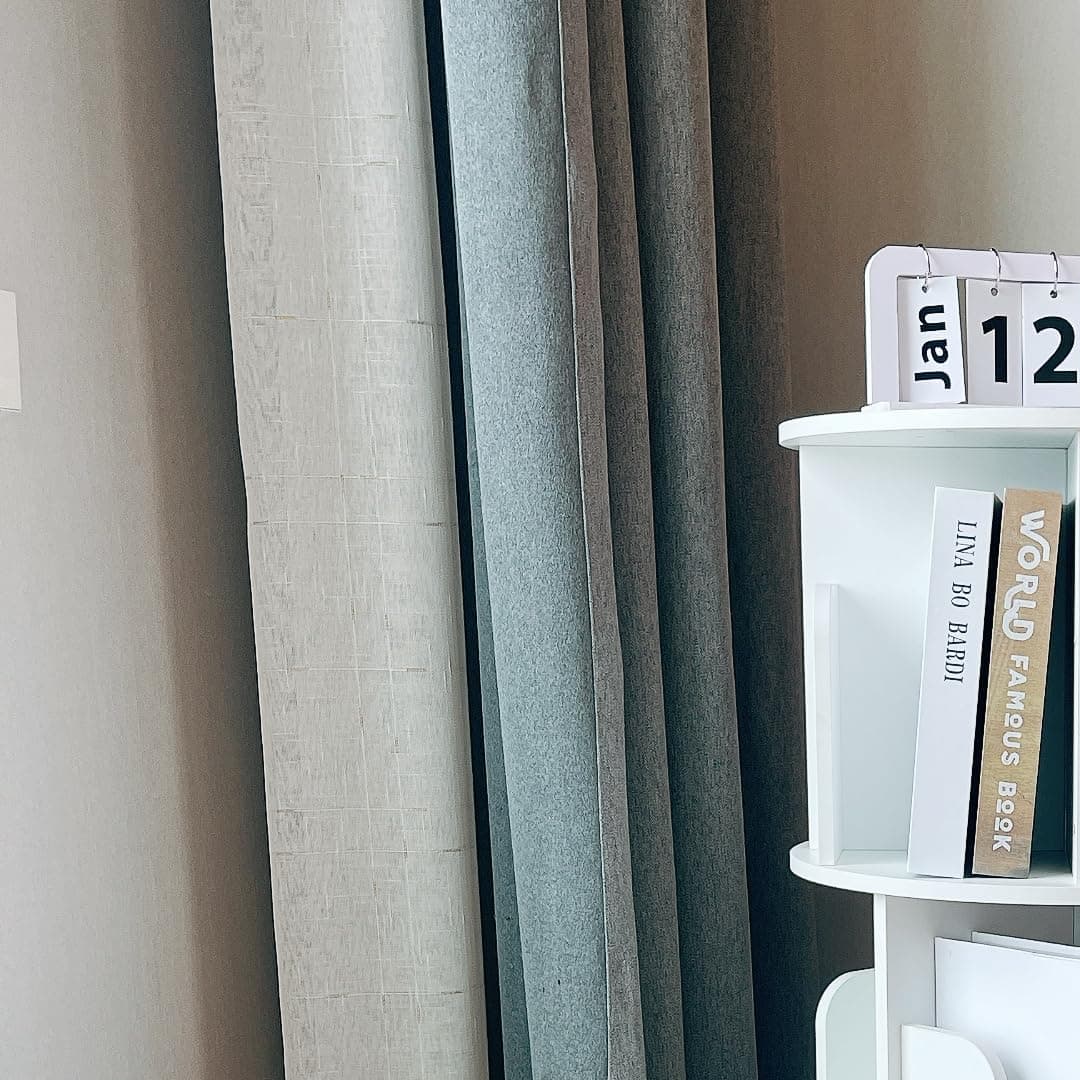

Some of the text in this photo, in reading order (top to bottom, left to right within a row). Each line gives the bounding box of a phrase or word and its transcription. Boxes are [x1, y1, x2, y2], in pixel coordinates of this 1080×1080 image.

[914, 304, 952, 389] Jan
[944, 520, 978, 684] LINA BO BARDI
[992, 510, 1051, 853] WORLD FAMOUS BOOK
